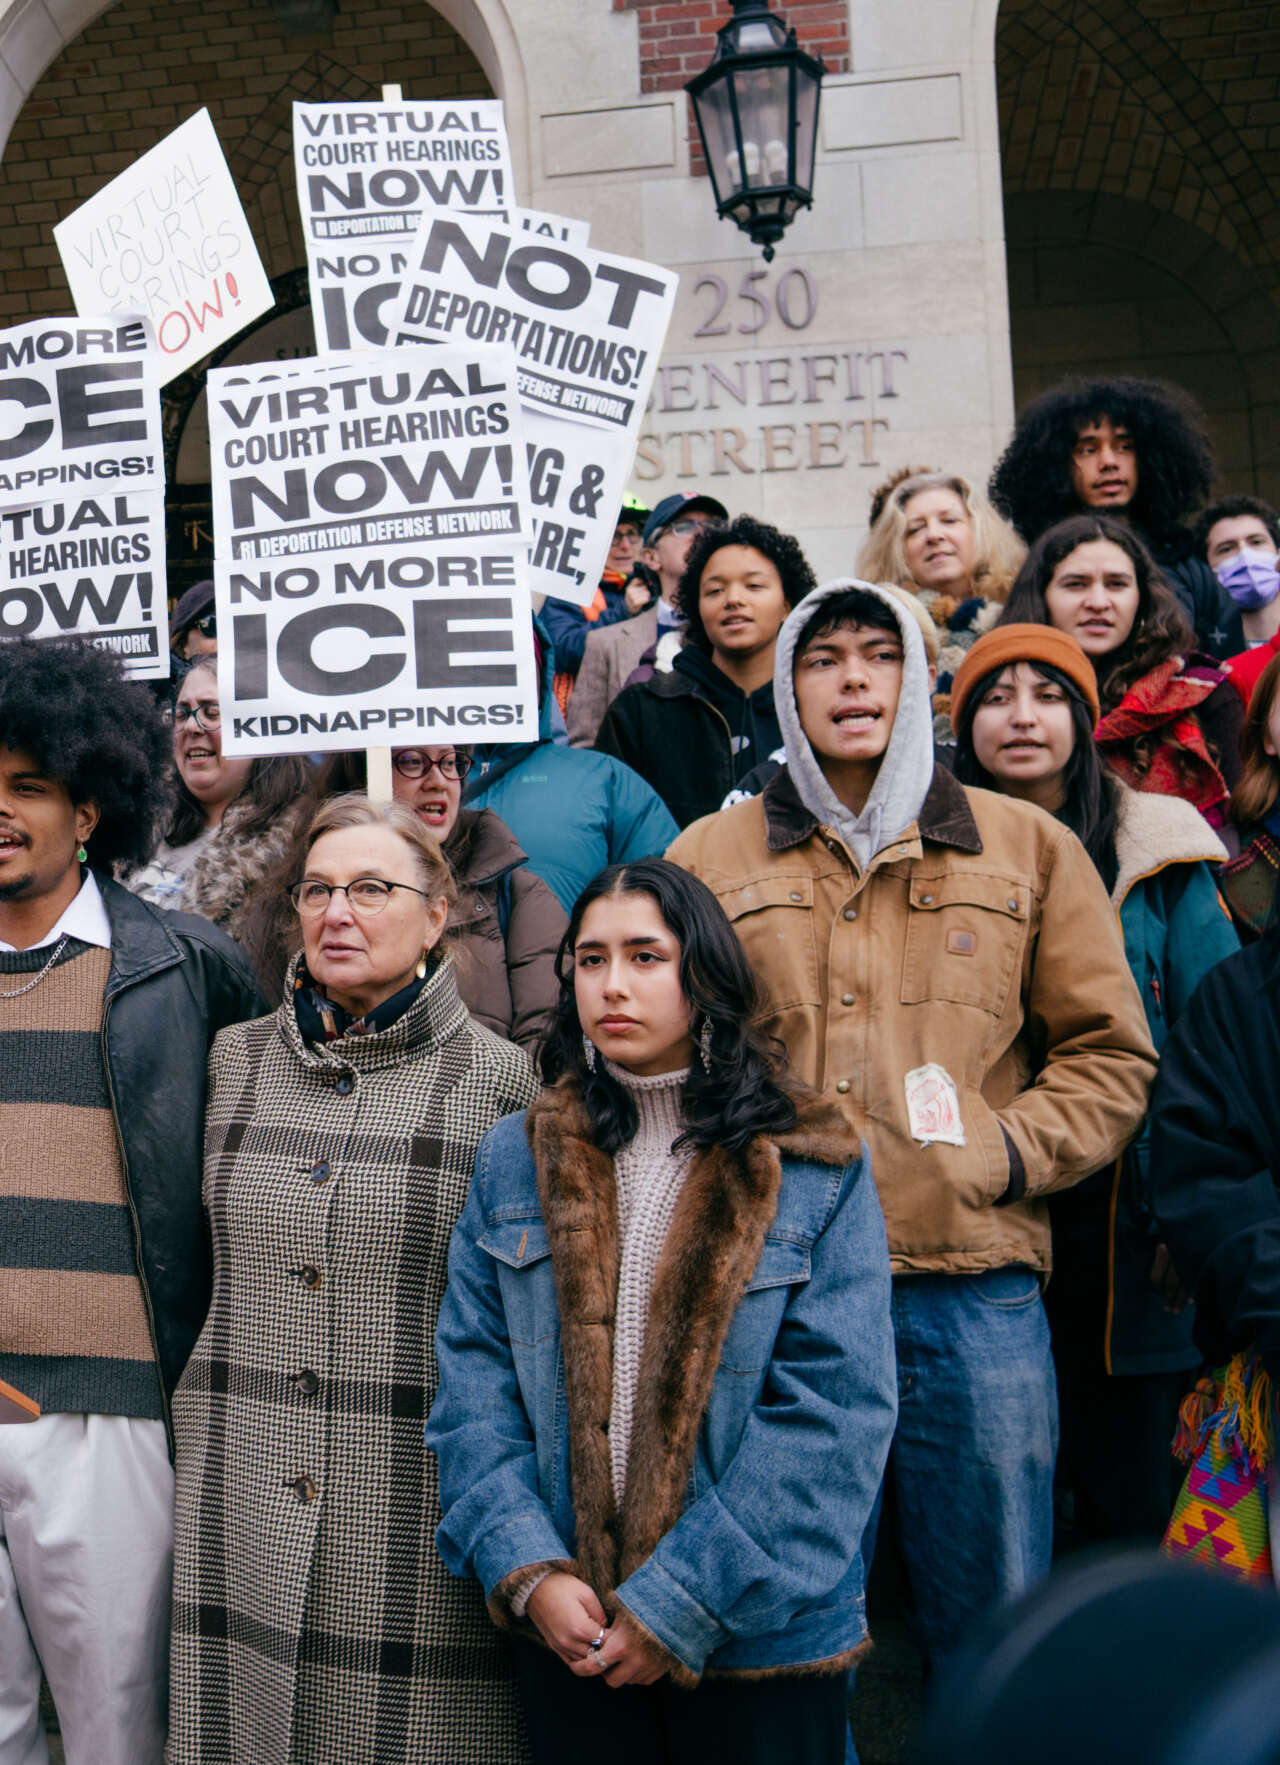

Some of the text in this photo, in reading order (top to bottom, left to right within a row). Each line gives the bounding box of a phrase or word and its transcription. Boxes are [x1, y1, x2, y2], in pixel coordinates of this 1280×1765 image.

[300, 111, 497, 137] VIRTUAL
[303, 139, 500, 167] COURT HEARINGS
[74, 154, 211, 269] VIRTUAL
[308, 168, 505, 212] NOW!
[99, 189, 205, 298] COURT
[329, 214, 404, 235] DEPORTATION
[316, 254, 381, 279] NO
[420, 219, 667, 329] NOT
[159, 272, 241, 353] OW!
[321, 282, 403, 350] IC
[693, 268, 818, 338] 250
[404, 284, 648, 391] DEPORTATIONS!
[219, 362, 506, 429] VIRTUAL
[561, 386, 630, 420] NETWORK
[645, 350, 909, 413] ENEFIT
[224, 402, 510, 468] COURT HEARINGS
[634, 418, 890, 481] STREET
[229, 444, 514, 530] NOW!
[569, 464, 605, 519] &
[9, 533, 151, 579] HEARINGS
[240, 509, 512, 561] RI DEPORTATION DEFENSE NETWORK
[229, 556, 515, 603] NO MORE
[233, 597, 518, 701] ICE
[233, 704, 525, 739] KIDNAPPINGS!
